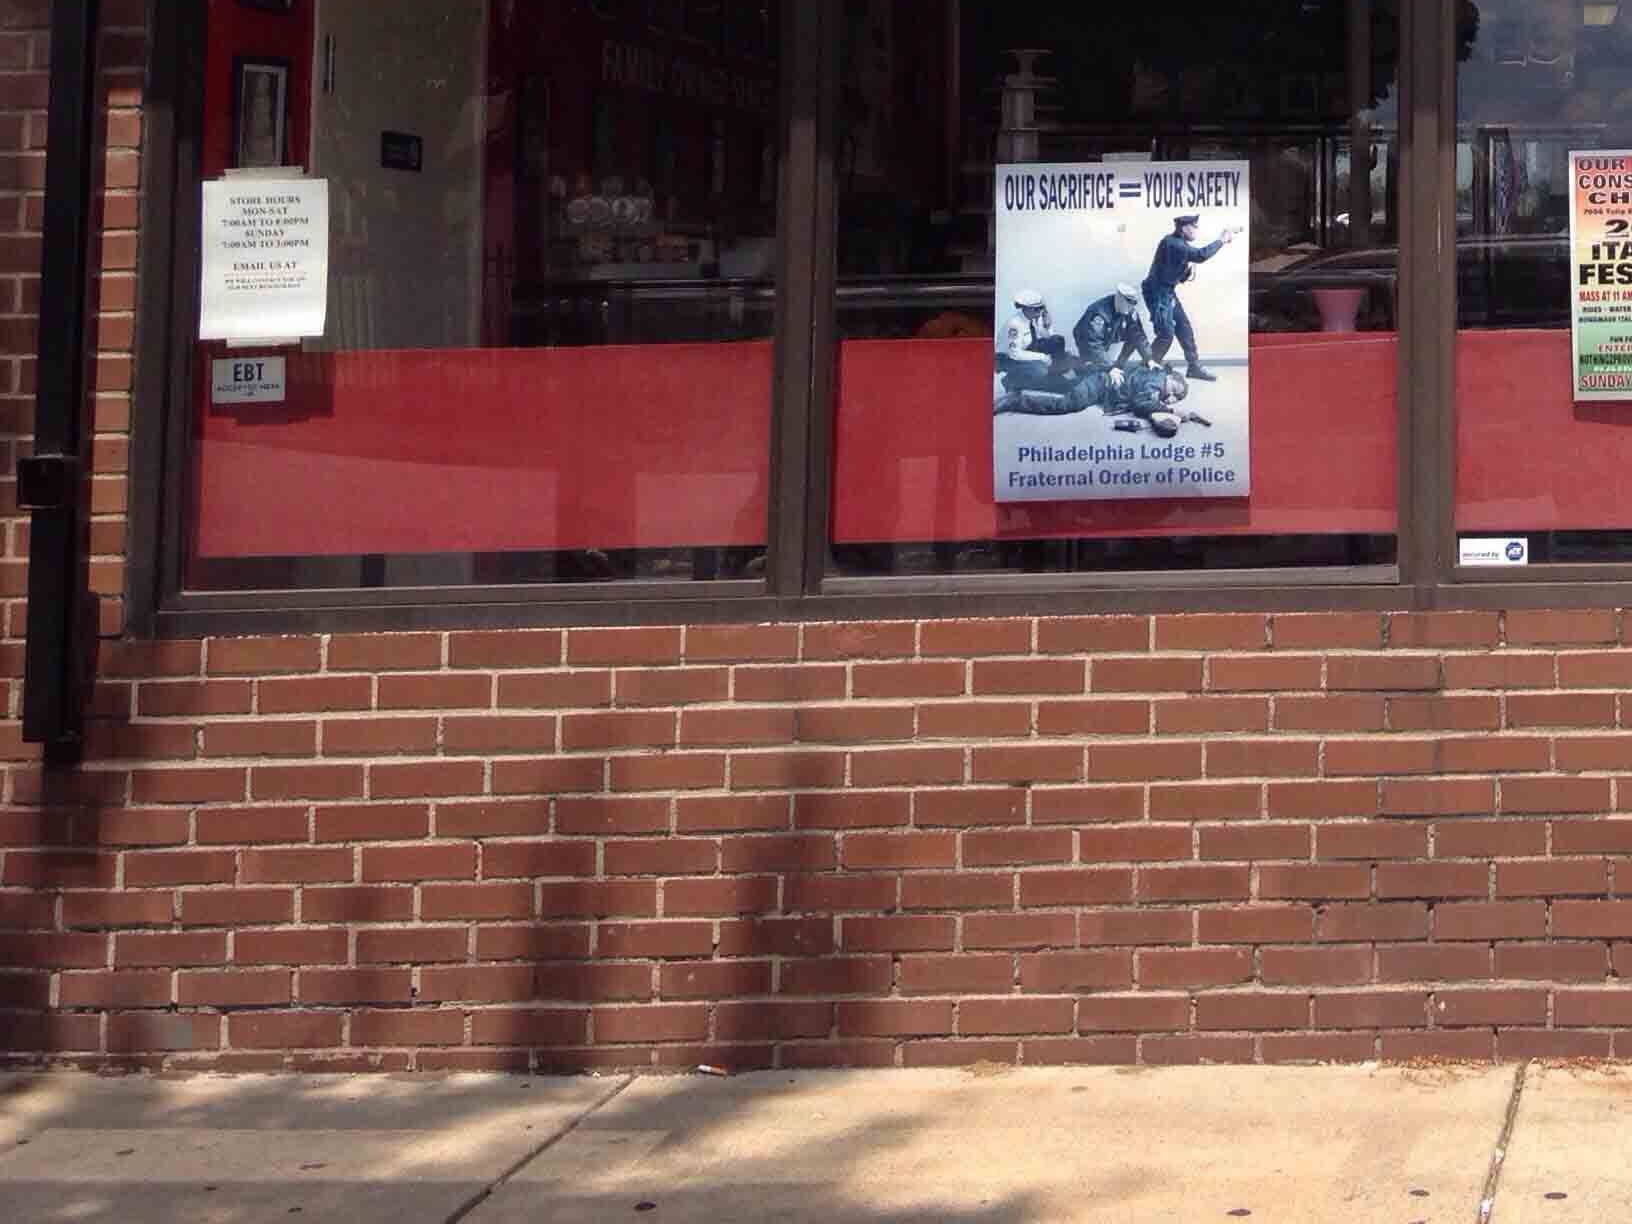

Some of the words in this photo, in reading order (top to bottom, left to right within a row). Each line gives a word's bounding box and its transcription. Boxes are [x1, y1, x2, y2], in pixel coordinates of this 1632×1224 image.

[1578, 158, 1625, 171] OUR
[1005, 173, 1035, 211] OUR
[1039, 172, 1115, 210] SACRIFICE
[1144, 171, 1184, 209] YOUR
[1187, 170, 1241, 207] SAFETY
[1579, 291, 1600, 302] MASS
[1602, 291, 1610, 301] AT
[1613, 291, 1620, 301] 11
[233, 363, 265, 382] EBT
[1581, 375, 1632, 388] SUNDAY
[1018, 444, 1135, 464] Philadelphia
[1140, 443, 1196, 463] Lodge
[1200, 442, 1225, 458] #5
[1008, 469, 1094, 488] Fraternal
[1099, 469, 1152, 486] Order
[1155, 467, 1174, 484] of
[1178, 466, 1236, 484] Police
